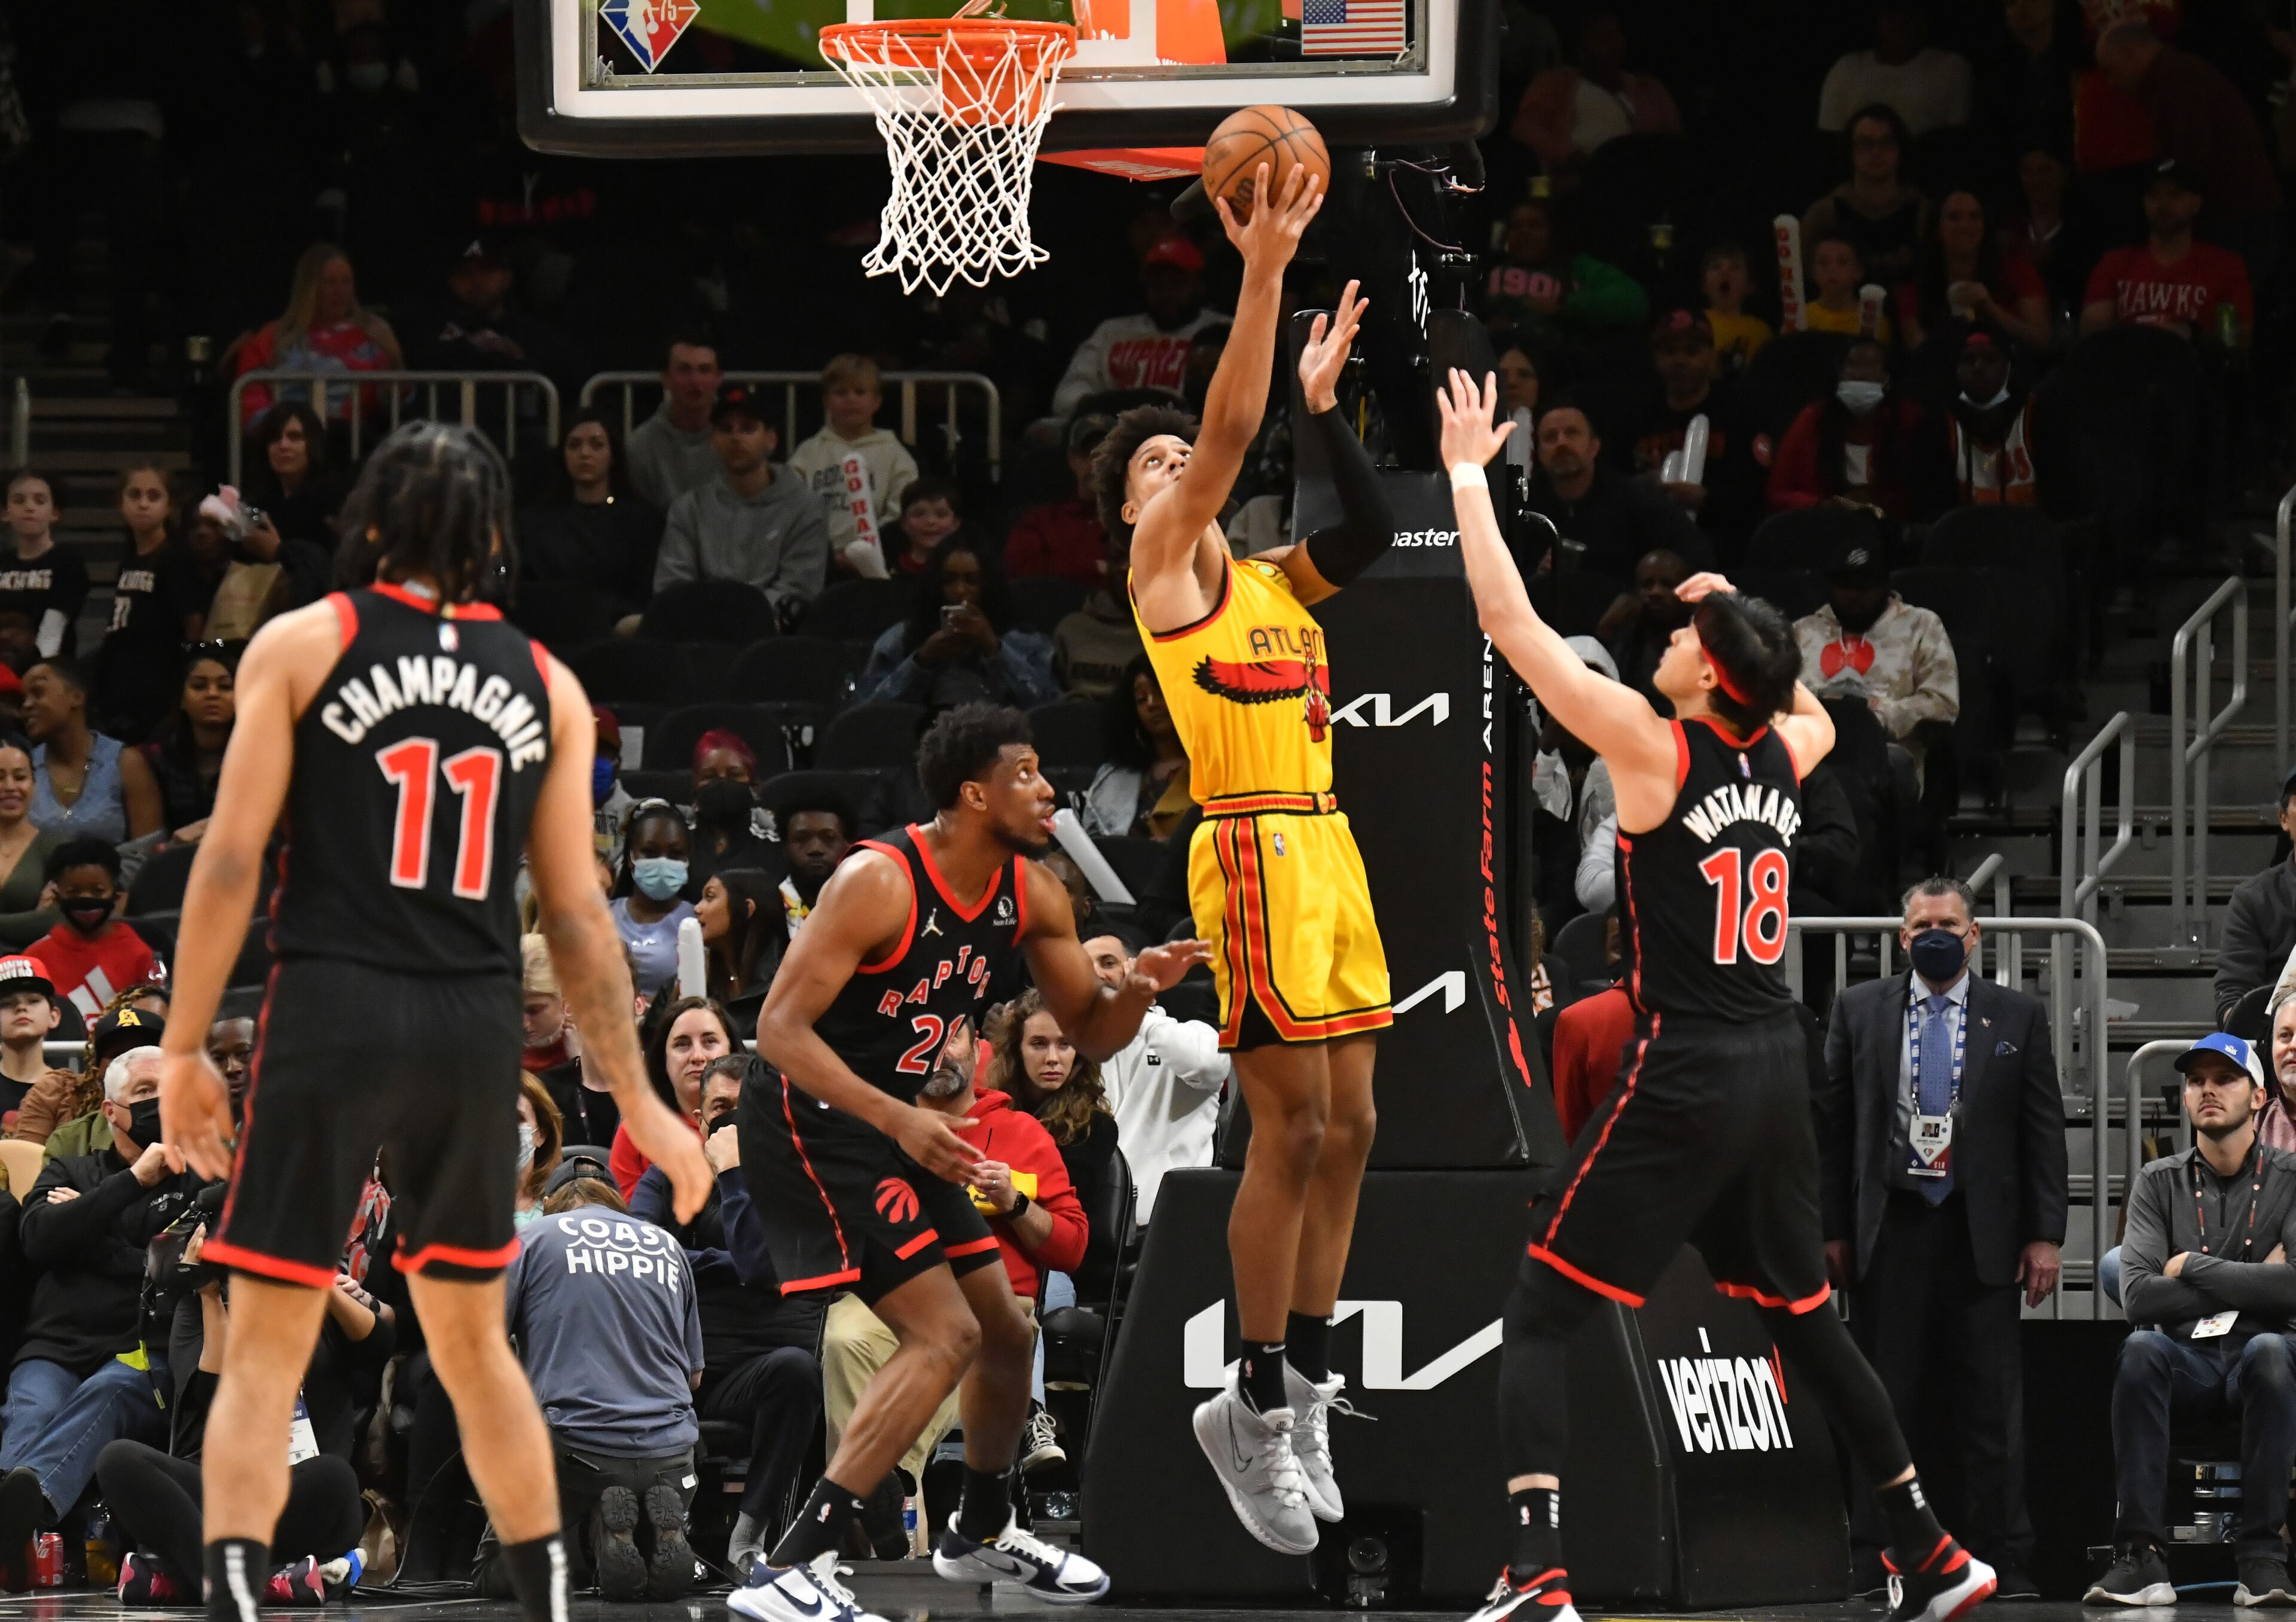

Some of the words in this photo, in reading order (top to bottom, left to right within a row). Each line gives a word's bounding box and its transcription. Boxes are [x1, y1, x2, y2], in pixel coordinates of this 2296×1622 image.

[321, 654, 546, 772] CHAMPAGNIE
[374, 735, 503, 901] 11
[1480, 760, 1494, 884] Farm
[1681, 782, 1803, 848] WATANABE
[1482, 886, 1513, 1012] State
[1697, 846, 1790, 966] 18
[557, 1217, 676, 1253] COAST
[565, 1248, 680, 1294] HIPPIE
[1657, 1326, 1794, 1455] verizon
